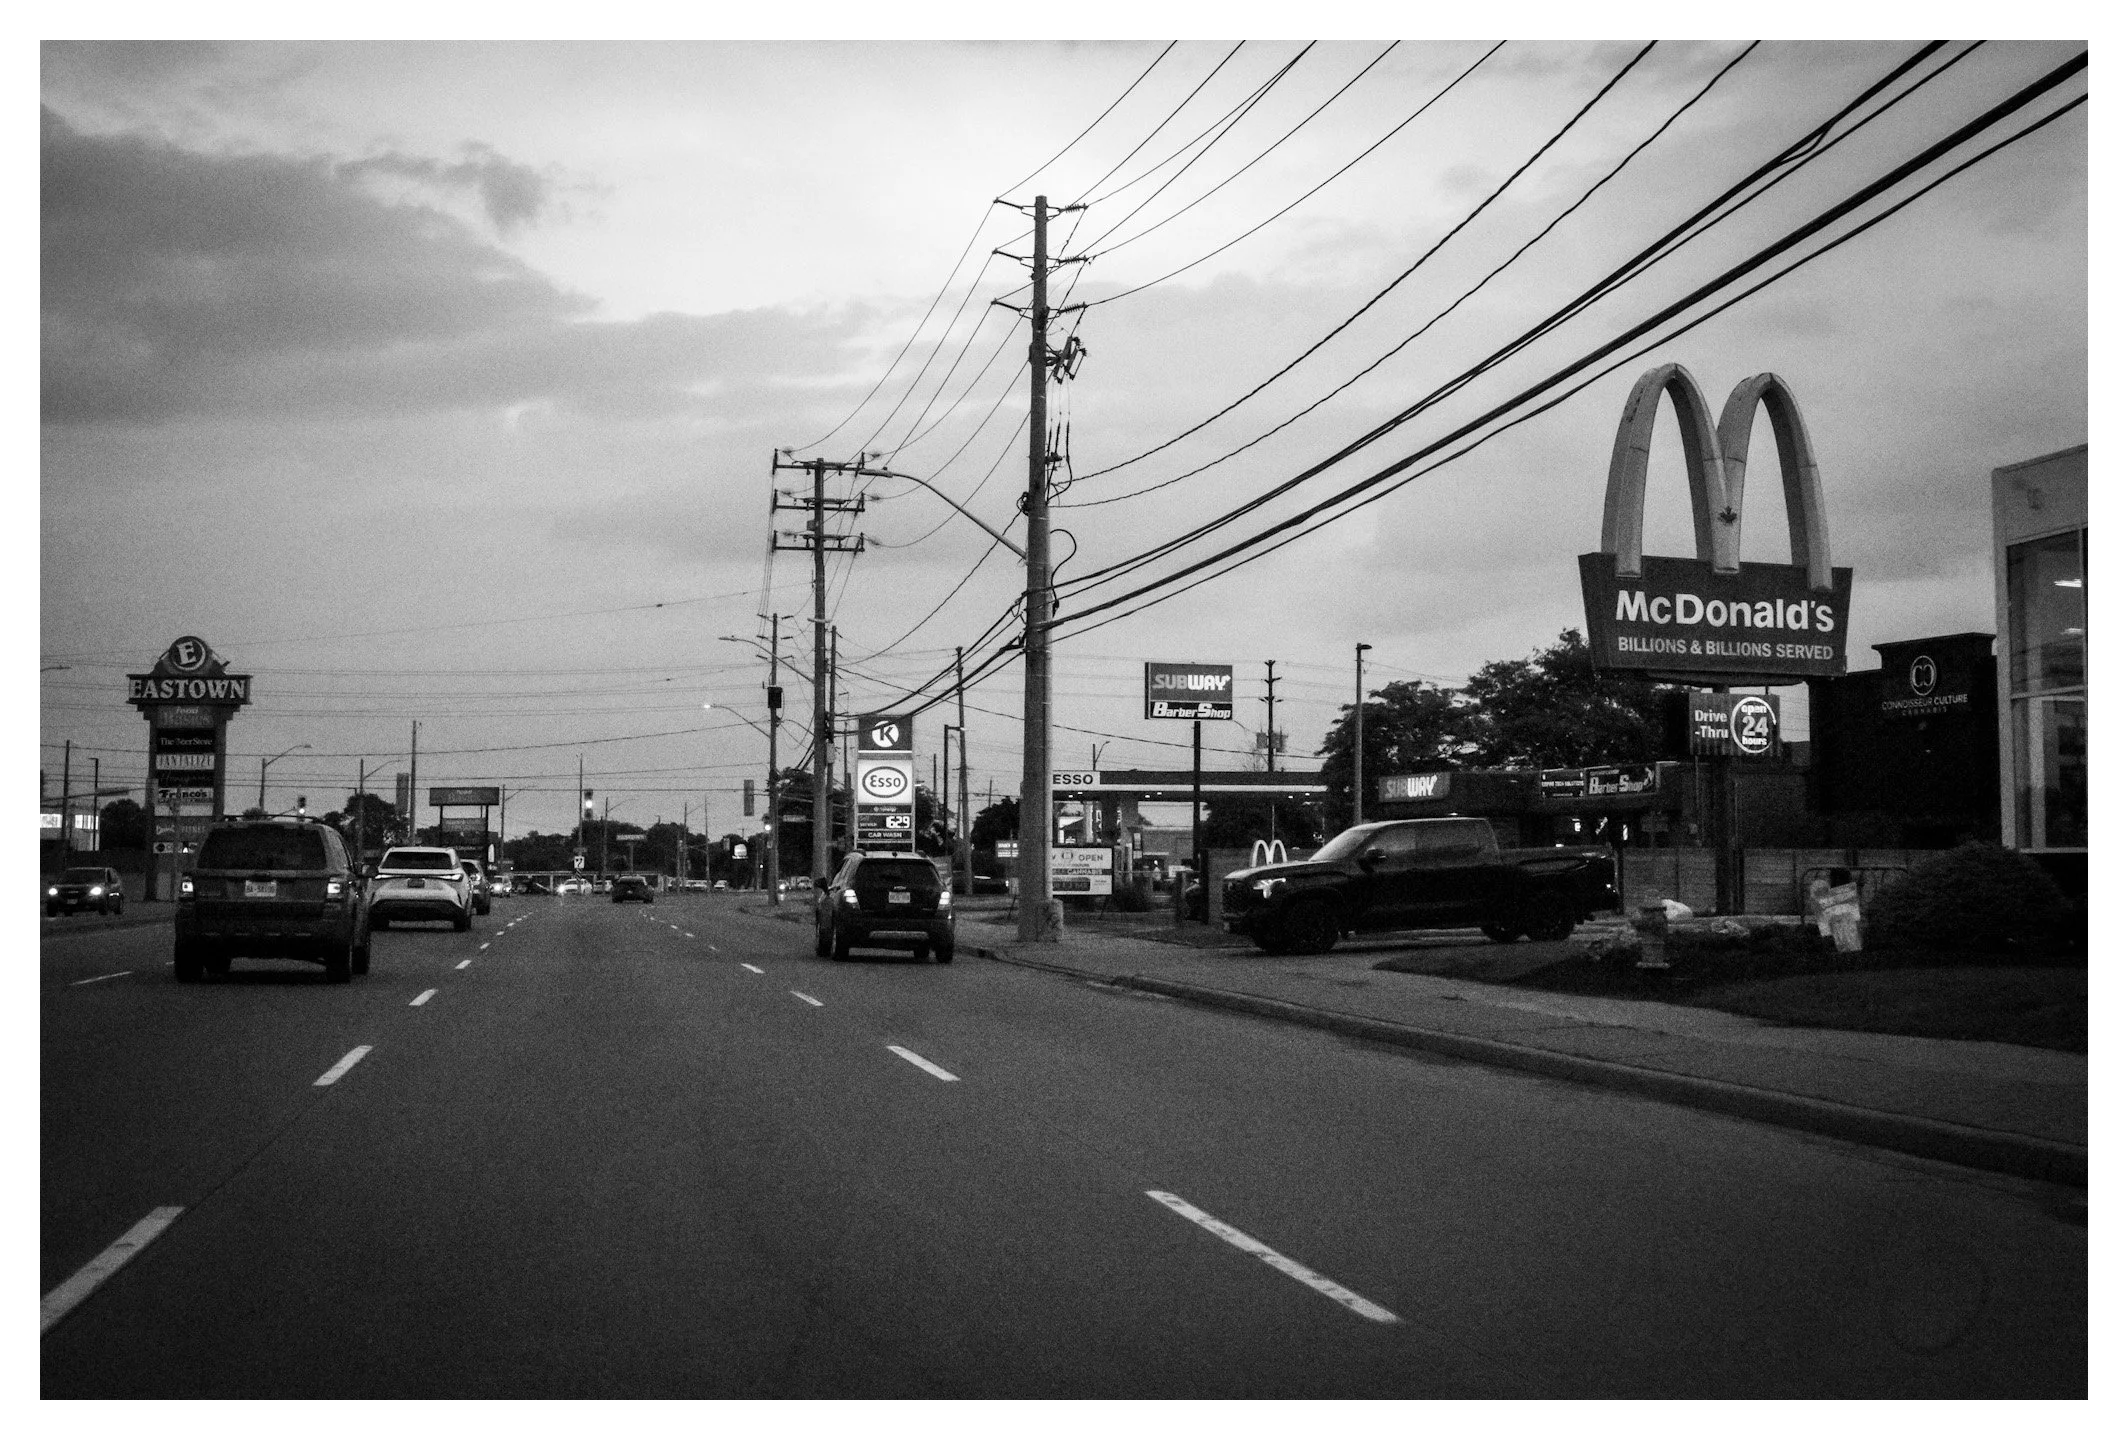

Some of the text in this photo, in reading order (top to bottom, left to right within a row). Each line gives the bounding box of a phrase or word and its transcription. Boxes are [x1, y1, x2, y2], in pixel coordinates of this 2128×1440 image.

[1615, 590, 1834, 632] McDonald's
[176, 640, 197, 665] E
[1618, 636, 1834, 660] BILLIONS & BILLIONS SERVED
[129, 679, 246, 699] EASTOWN
[1152, 674, 1231, 691] SUBWAY
[1933, 693, 1968, 706] CULTURE
[1695, 709, 1727, 723] Drive
[1741, 704, 1766, 716] open
[1742, 715, 1768, 737] 24
[1741, 736, 1767, 746] hours
[870, 774, 901, 788] Esso
[1052, 774, 1094, 785] ESSO
[1384, 774, 1438, 799] SUBWAY
[158, 788, 207, 799] Frnco's
[1078, 854, 1104, 862] OPEN
